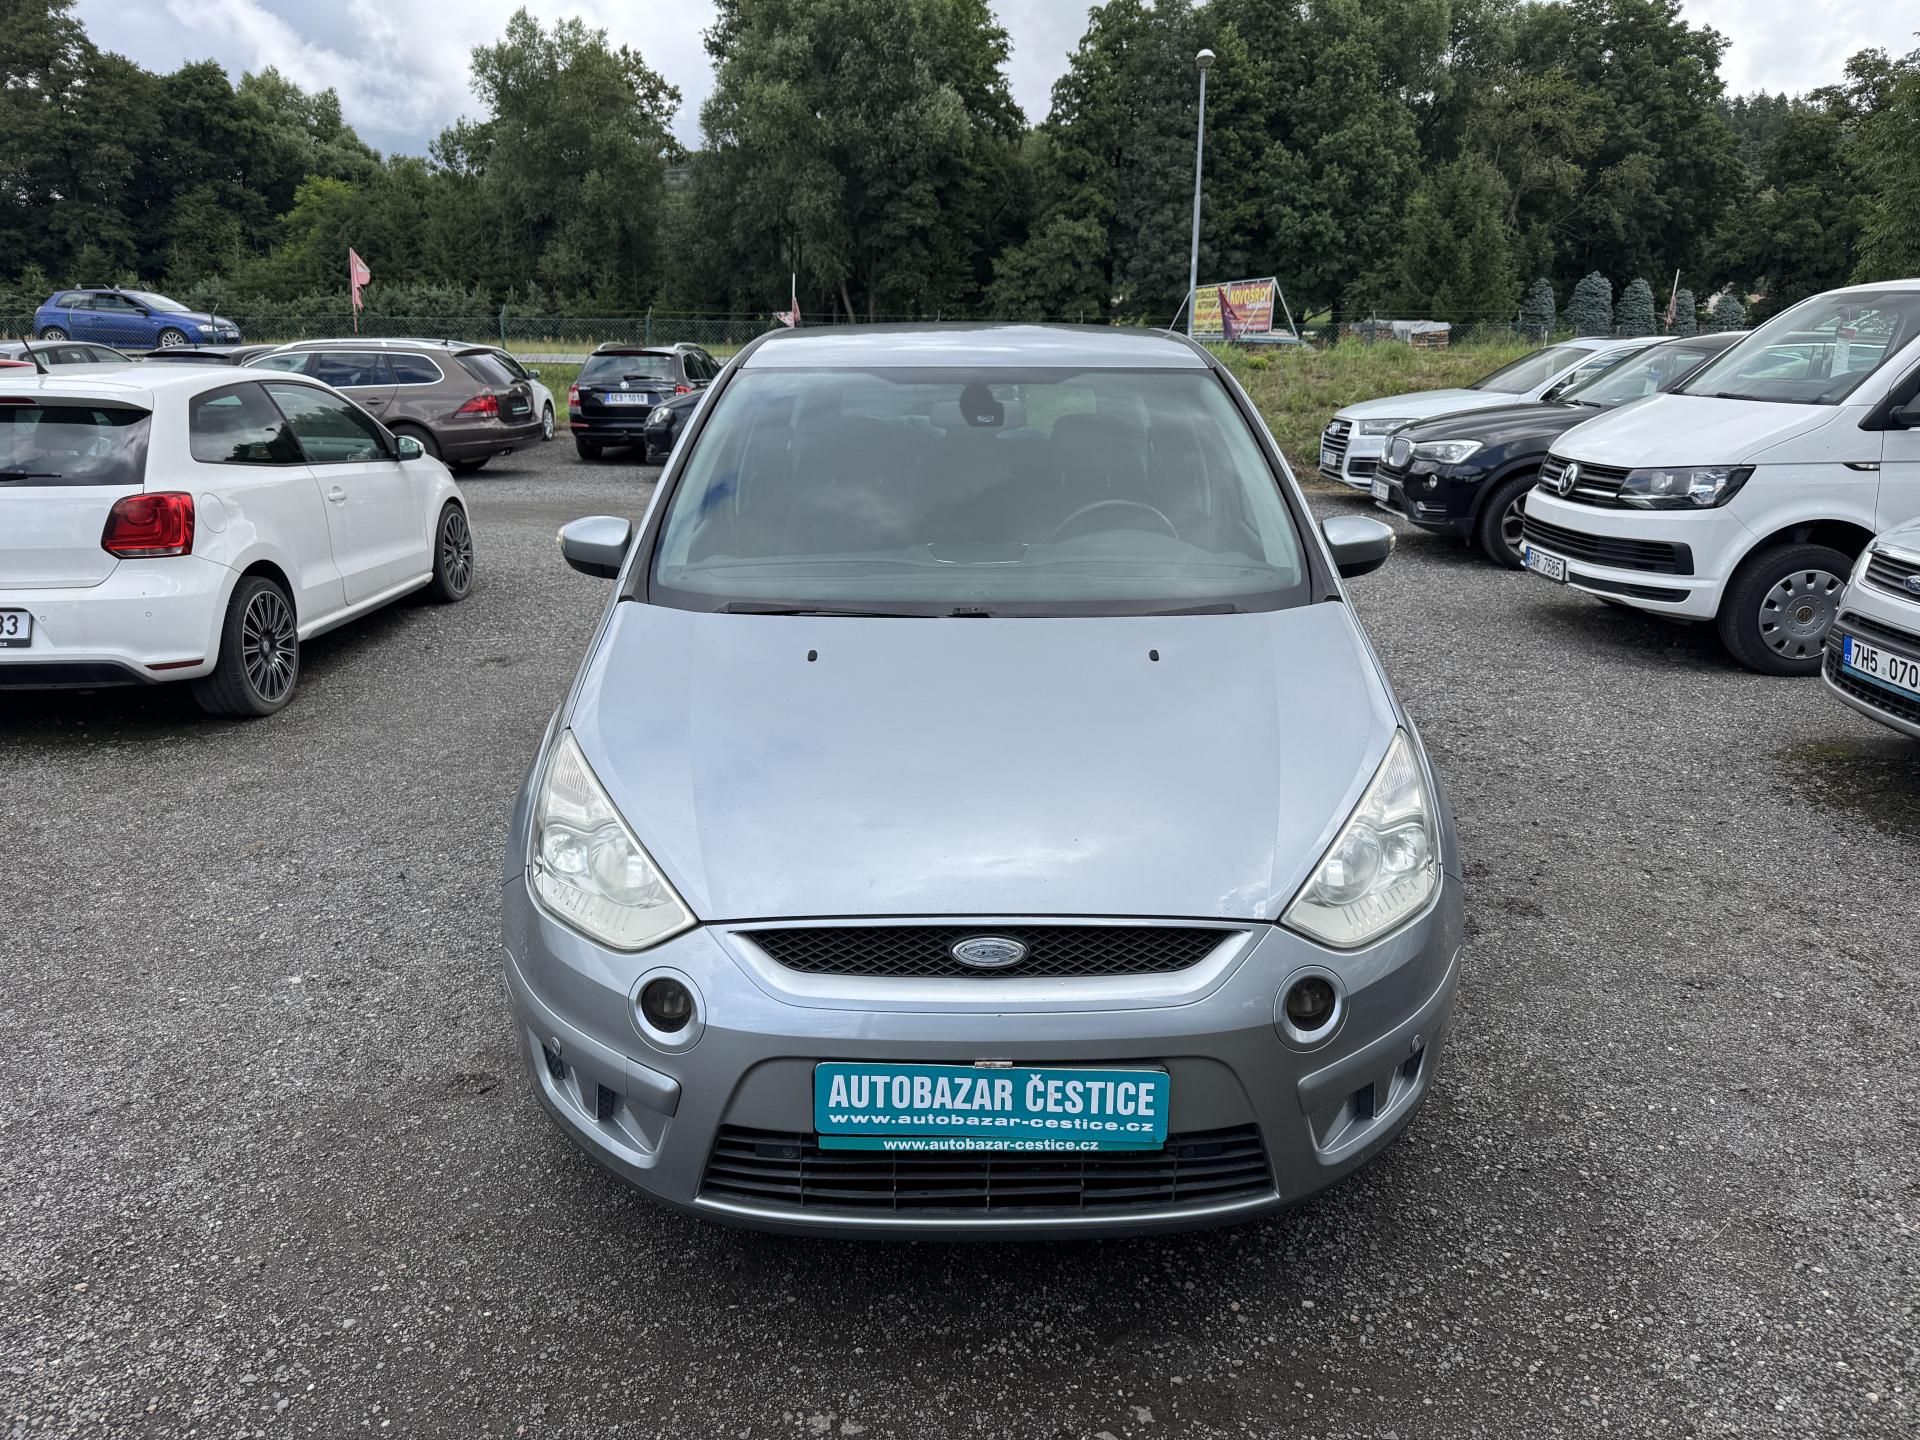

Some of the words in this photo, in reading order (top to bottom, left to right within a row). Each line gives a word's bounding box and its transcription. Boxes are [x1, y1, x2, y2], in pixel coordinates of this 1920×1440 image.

[1853, 642, 1878, 673] 7H5
[1889, 657, 1920, 688] 070
[828, 1074, 1013, 1111] AUTOBAZAR
[1025, 1073, 1155, 1116] ČESTICE
[828, 1114, 1154, 1132] www.autobazar-cestice.cz
[883, 1138, 1099, 1151] www.autobazar-cestice.cz
